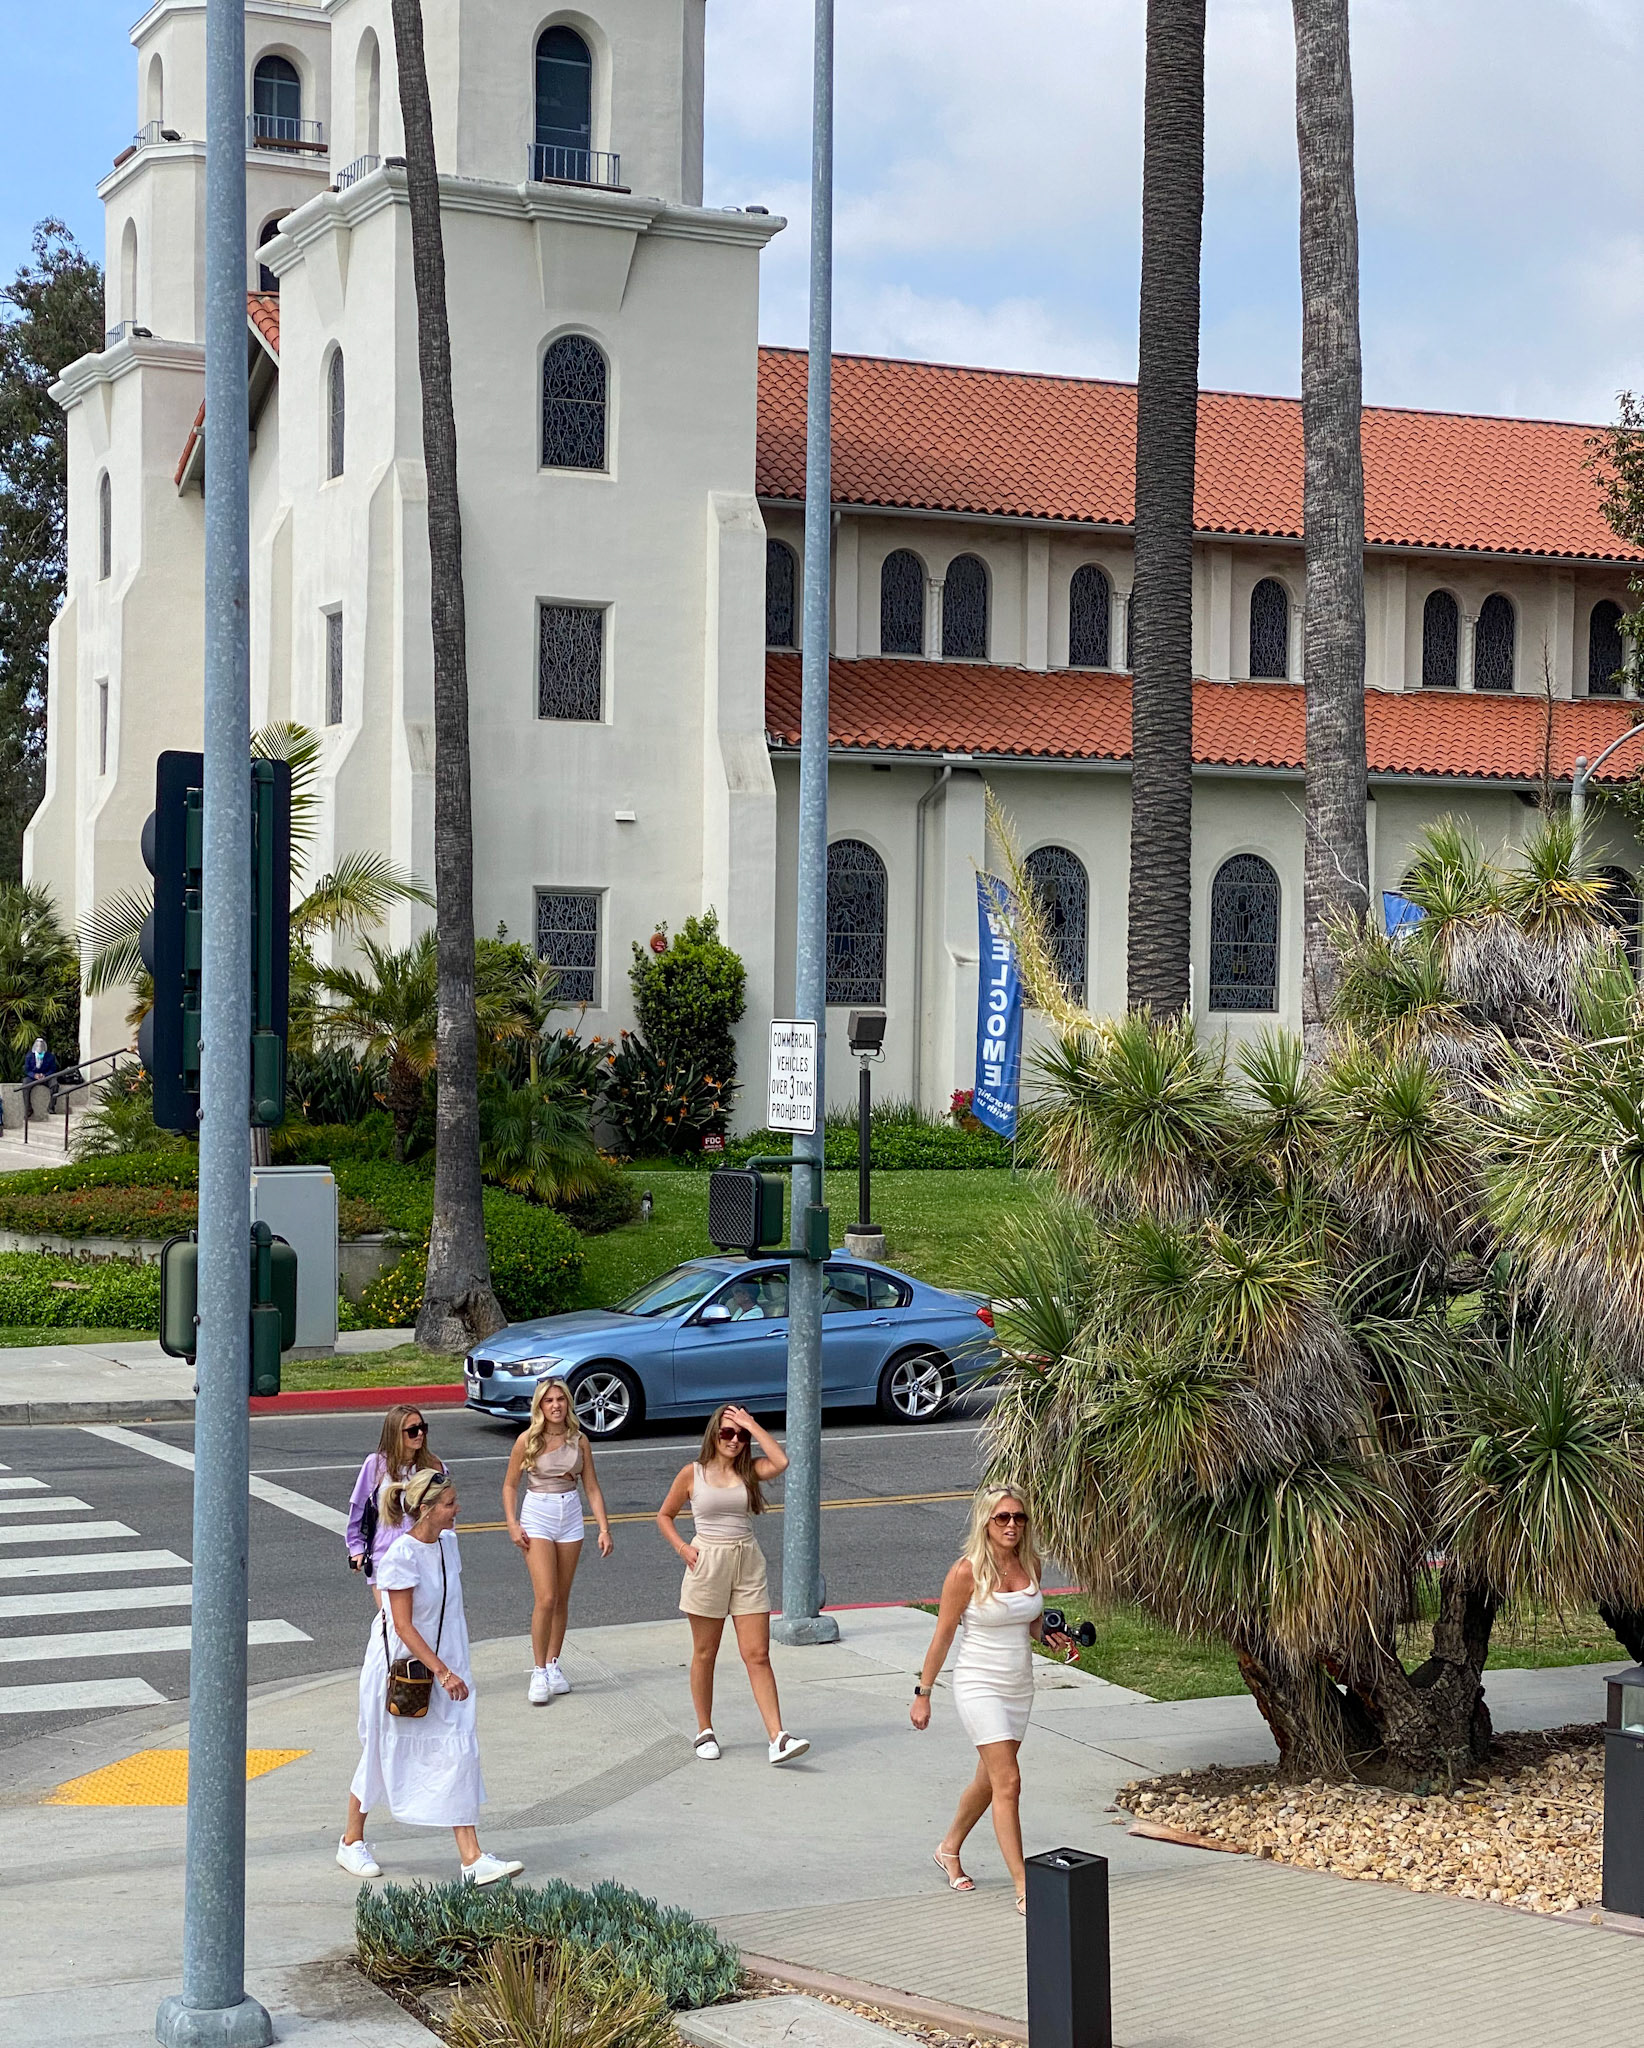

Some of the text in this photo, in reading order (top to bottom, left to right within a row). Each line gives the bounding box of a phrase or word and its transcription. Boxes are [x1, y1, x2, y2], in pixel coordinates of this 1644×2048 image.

[773, 1032, 812, 1048] COMMERCIAL
[777, 1056, 808, 1072] VEHICLES
[772, 1075, 813, 1100] OVER 3 TONS
[772, 1103, 811, 1120] PROHIBITED
[705, 1136, 721, 1144] FDC
